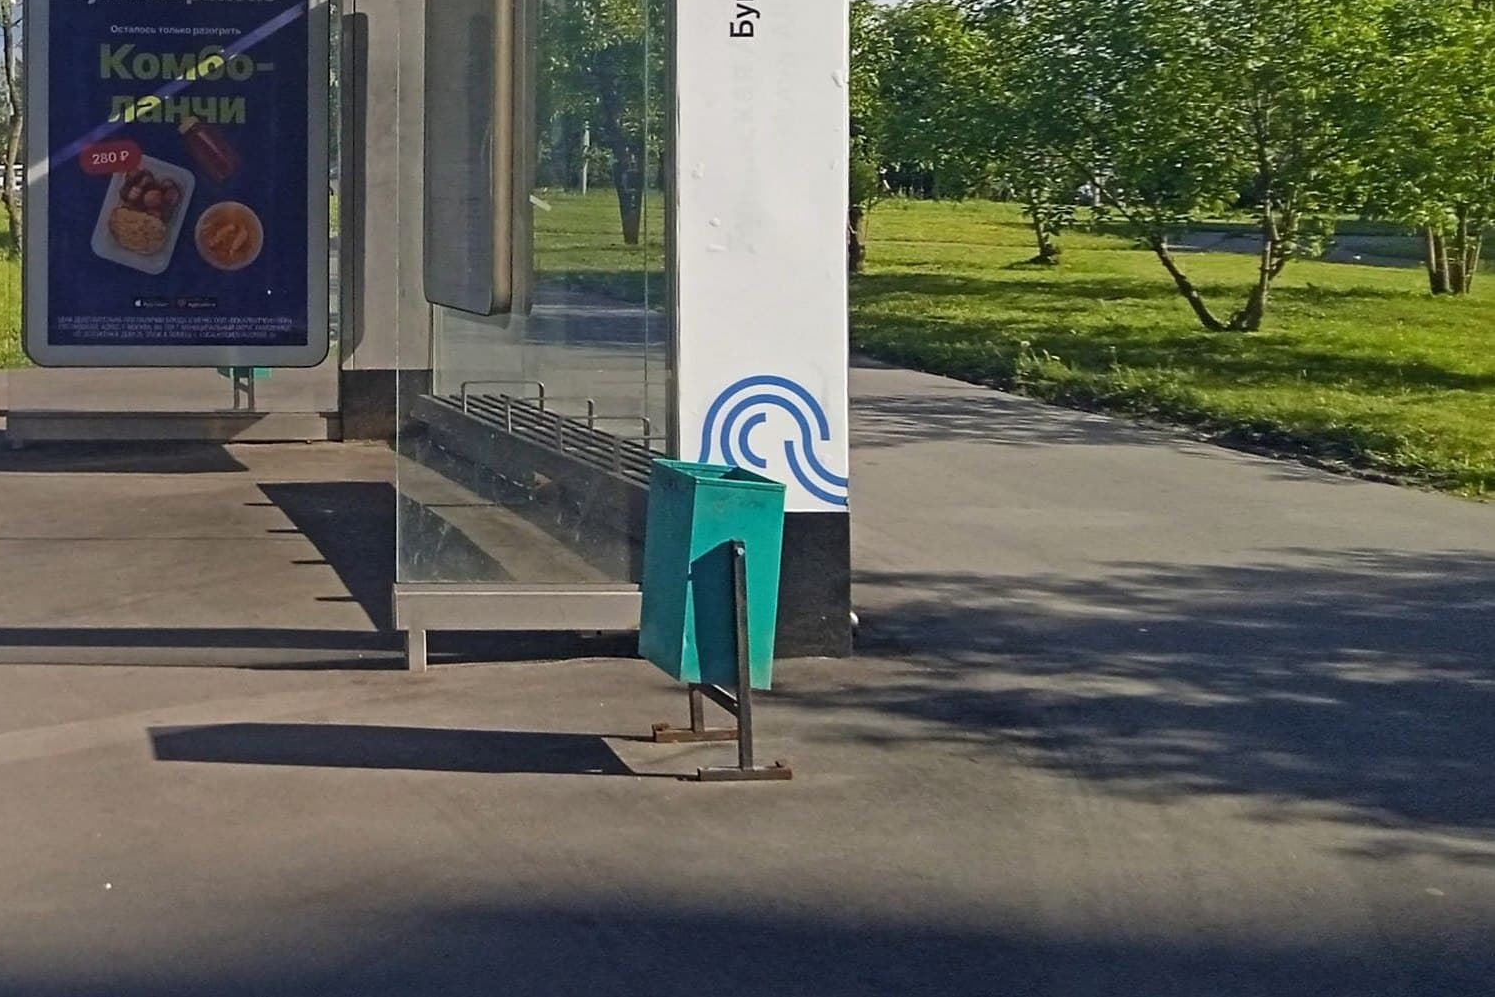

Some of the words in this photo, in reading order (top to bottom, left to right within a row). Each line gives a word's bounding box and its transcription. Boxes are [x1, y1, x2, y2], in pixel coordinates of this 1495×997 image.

[110, 24, 157, 35] Осталось
[159, 26, 192, 36] только
[193, 27, 242, 36] разогреть
[99, 43, 274, 82] Комбо-
[107, 95, 247, 124] ланчи
[91, 151, 118, 165] 280
